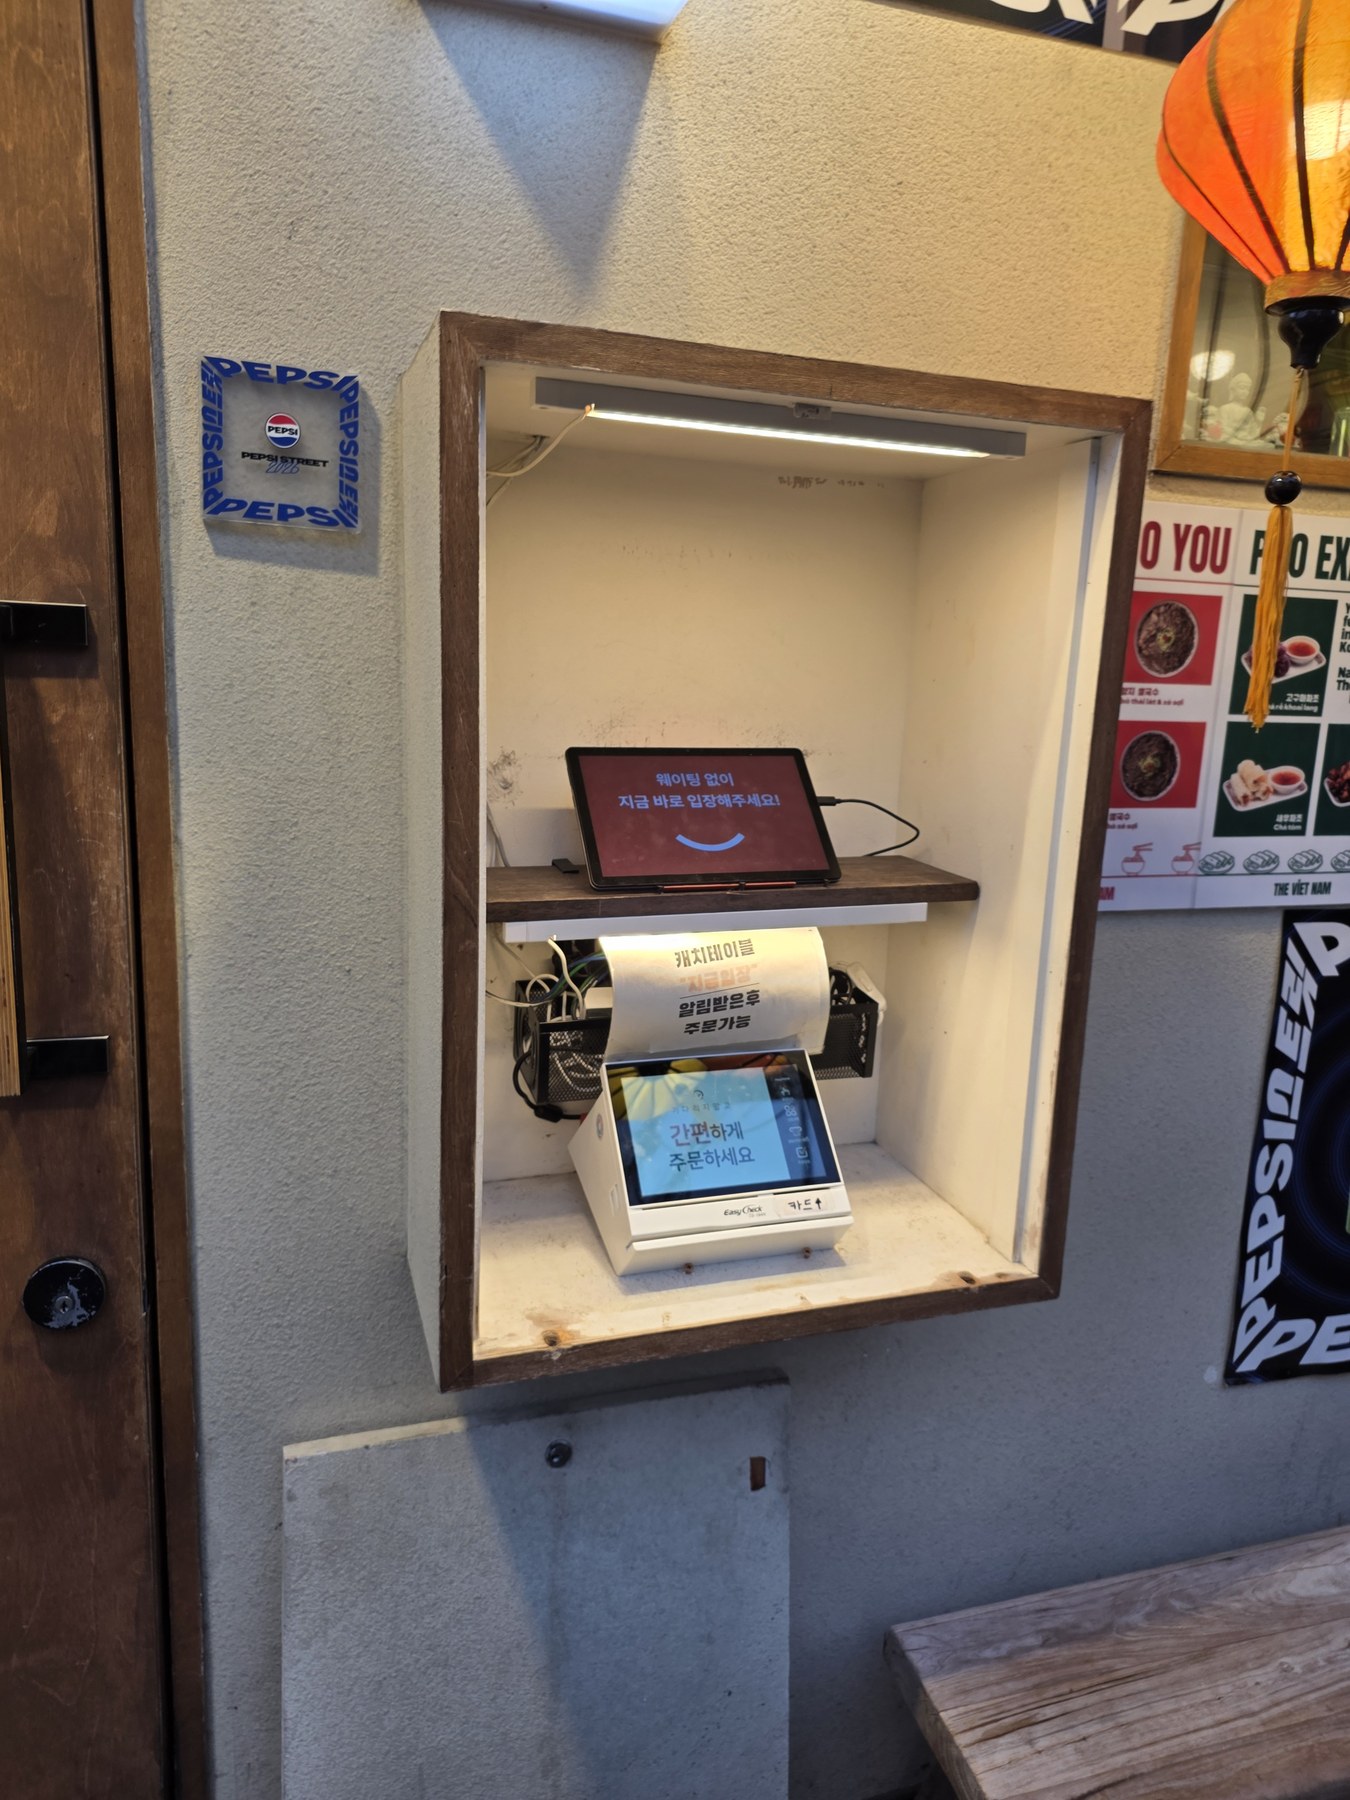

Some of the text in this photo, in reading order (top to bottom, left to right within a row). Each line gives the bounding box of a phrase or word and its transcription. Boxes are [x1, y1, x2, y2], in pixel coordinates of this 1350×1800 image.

[203, 356, 358, 392] PEPSI
[267, 425, 298, 436] PEPSI
[241, 451, 329, 467] PEPSI STREET
[206, 498, 357, 528] PEPSI
[1173, 523, 1232, 574] YOU
[1249, 530, 1309, 578] PO
[656, 772, 734, 787] 웨이팅 없이
[618, 793, 780, 809] 지금 바로 입장해주세요!
[1274, 883, 1289, 896] THE
[1311, 882, 1332, 895] NAM
[674, 938, 756, 969] 캐치테이블
[683, 1015, 752, 1035] 주문가능
[669, 1121, 745, 1147] 간편하게
[669, 1146, 756, 1172] 주문하세요
[788, 1199, 812, 1211] 카드
